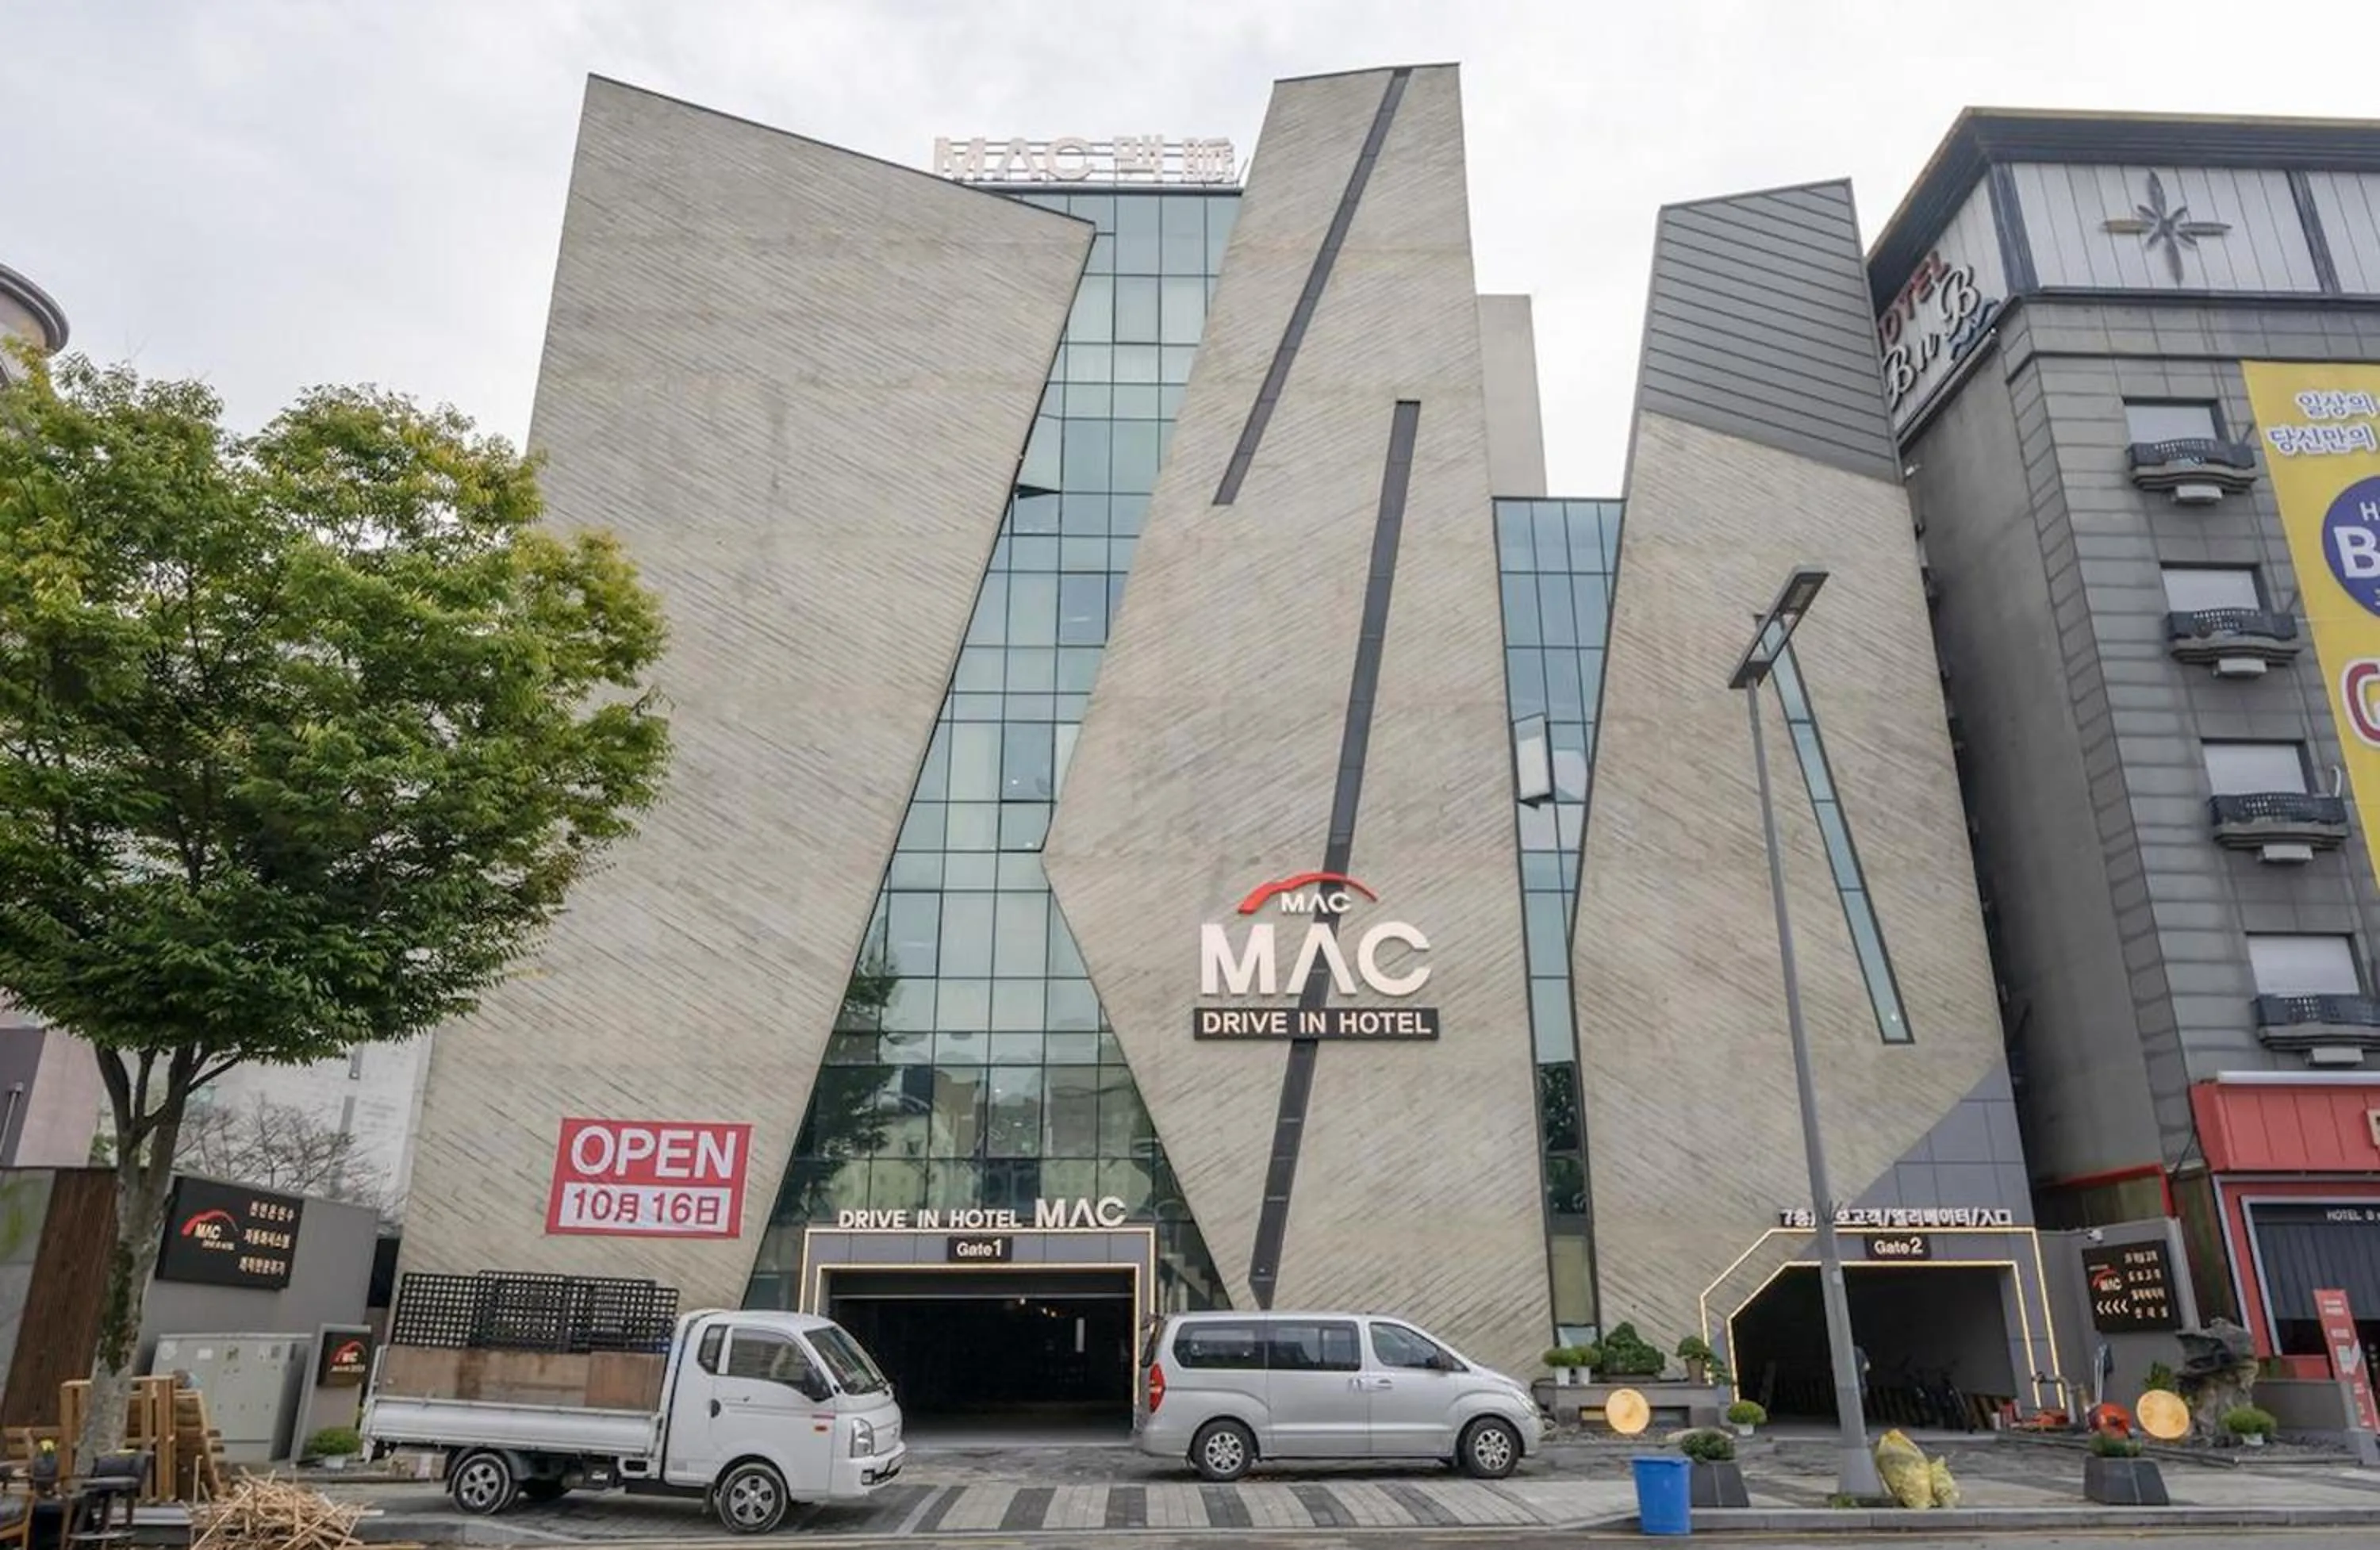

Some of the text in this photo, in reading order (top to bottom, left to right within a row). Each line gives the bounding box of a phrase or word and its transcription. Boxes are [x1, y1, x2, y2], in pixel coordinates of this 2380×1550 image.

[934, 136, 1096, 182] MAC
[1879, 250, 1951, 353] OTEL
[2297, 391, 2376, 418] 일상의
[2268, 424, 2376, 454] 당신만의
[1280, 892, 1352, 914] MAC
[1200, 921, 1432, 996] MAC
[1203, 1012, 1432, 1034] DRIVE IN HOTEL
[570, 1125, 737, 1179] OPEN
[574, 1189, 721, 1226] 10月 16日
[838, 1196, 1127, 1229] DRIVE IN HOTEL MAC
